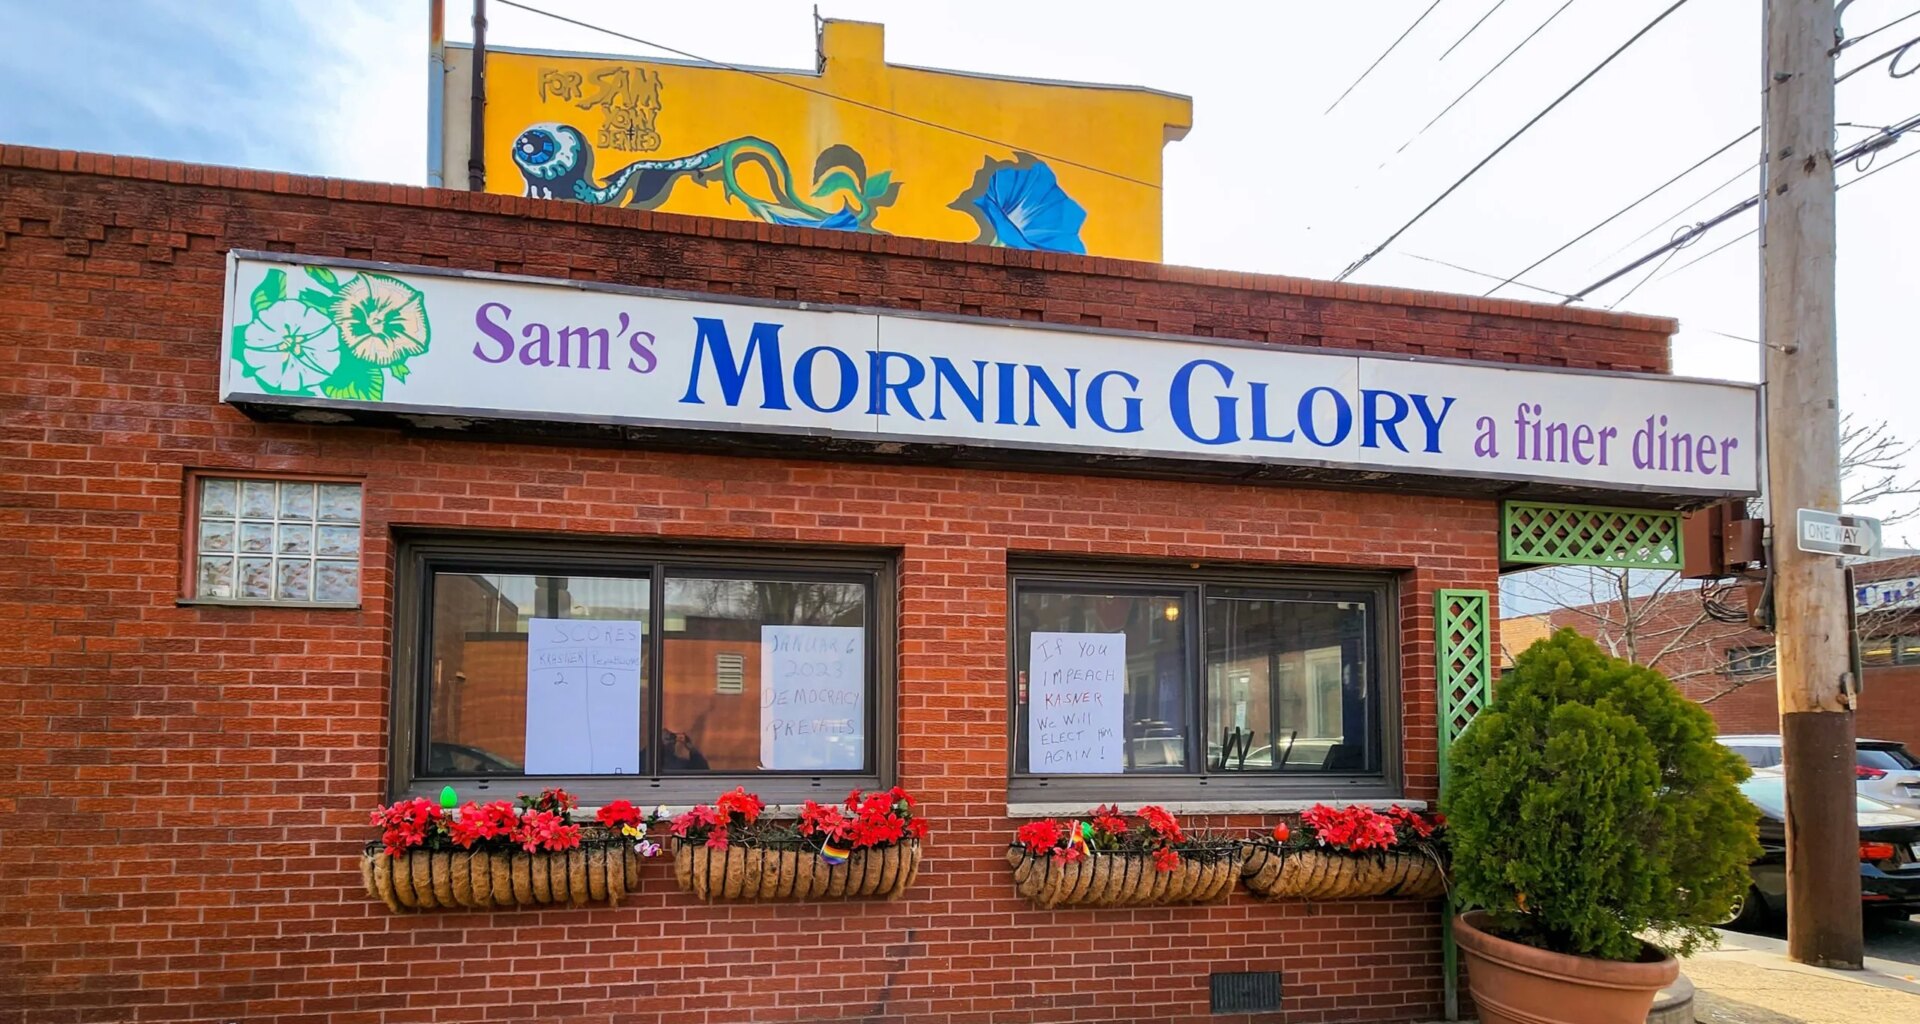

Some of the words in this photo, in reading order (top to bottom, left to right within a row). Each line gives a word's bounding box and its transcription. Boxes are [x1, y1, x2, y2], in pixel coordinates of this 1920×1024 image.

[539, 67, 583, 103] FOR
[575, 66, 664, 111] SAM
[472, 302, 658, 374] Sam's
[679, 317, 1144, 433] MORNING
[1169, 360, 1457, 453] GLORY
[1474, 416, 1499, 458] a
[1514, 403, 1618, 466] finer
[1633, 414, 1738, 476] diner
[1808, 523, 1831, 541] ONE
[1834, 527, 1859, 544] WAY
[551, 624, 637, 644] SCORES
[845, 638, 856, 654] 6
[553, 671, 569, 686] 2
[783, 659, 844, 679] 2023
[1043, 669, 1115, 686] IMPEACH
[761, 687, 860, 709] DEMOCRACY
[1045, 692, 1104, 710] KASNER
[1041, 729, 1085, 746] ELECT
